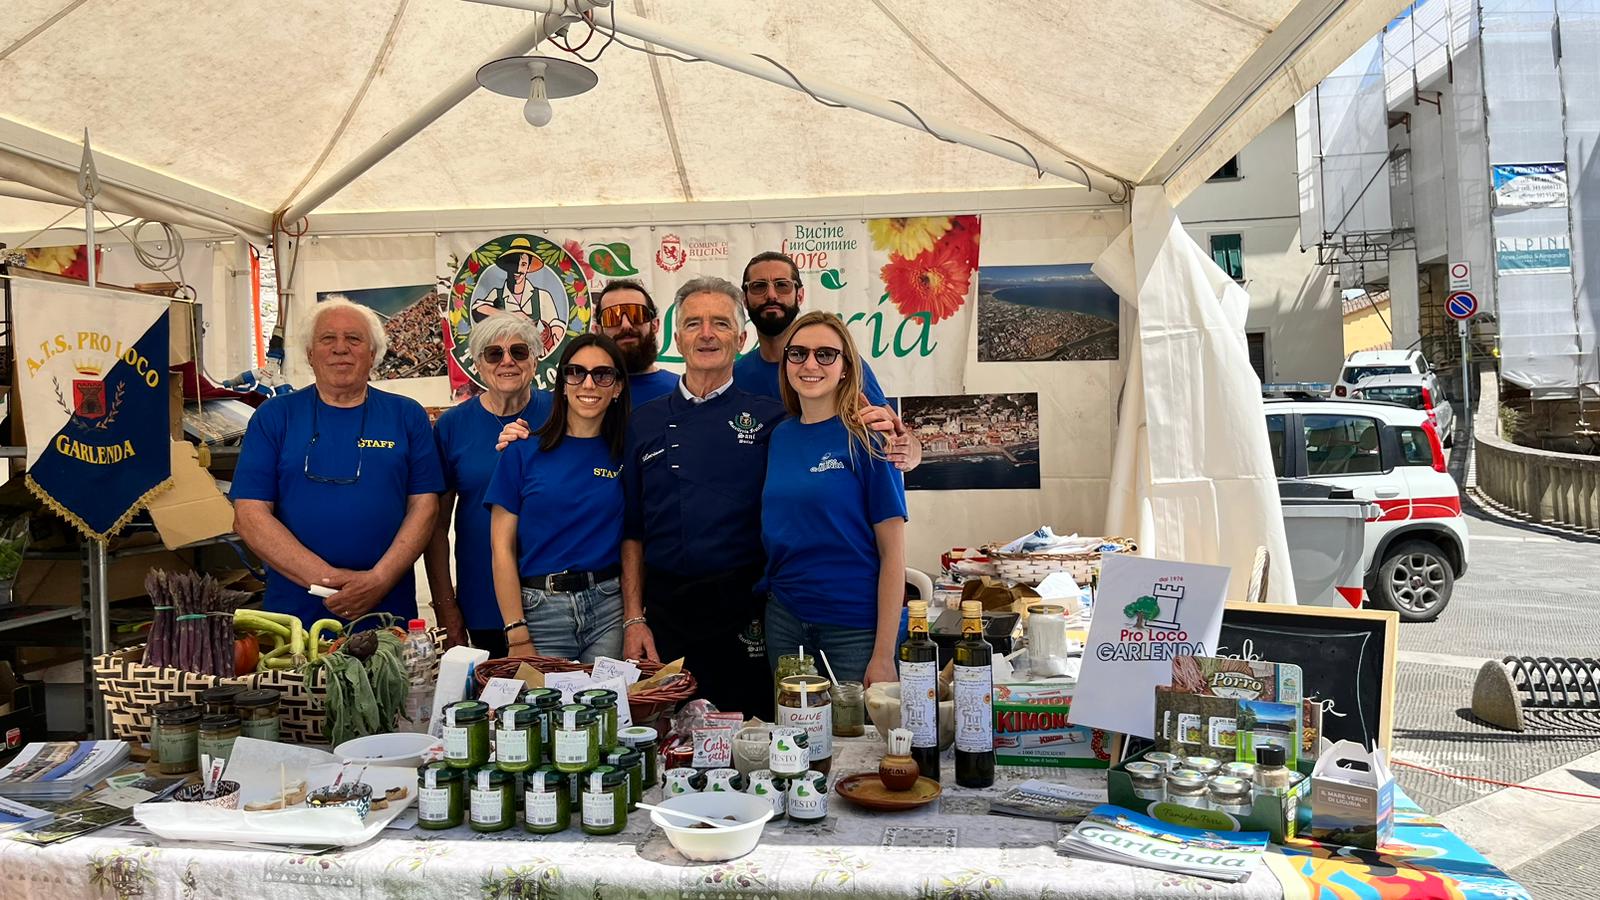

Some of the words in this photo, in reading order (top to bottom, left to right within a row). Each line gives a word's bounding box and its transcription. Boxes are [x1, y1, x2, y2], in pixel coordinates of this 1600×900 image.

[795, 224, 845, 240] Bucine
[1499, 236, 1566, 251] ALPINI
[688, 247, 729, 257] BUCINE
[77, 331, 112, 353] PRO
[115, 340, 160, 388] LOCO
[56, 434, 136, 465] GARLENDA
[357, 438, 395, 449] STAFF
[1120, 629, 1144, 641] Pro
[1148, 629, 1188, 641] Loco
[1096, 642, 1208, 662] GARLENDA
[1211, 671, 1262, 691] Porro
[790, 711, 822, 722] OLIVE
[790, 799, 817, 808] PESTO
[1076, 824, 1247, 867] Garlenda
